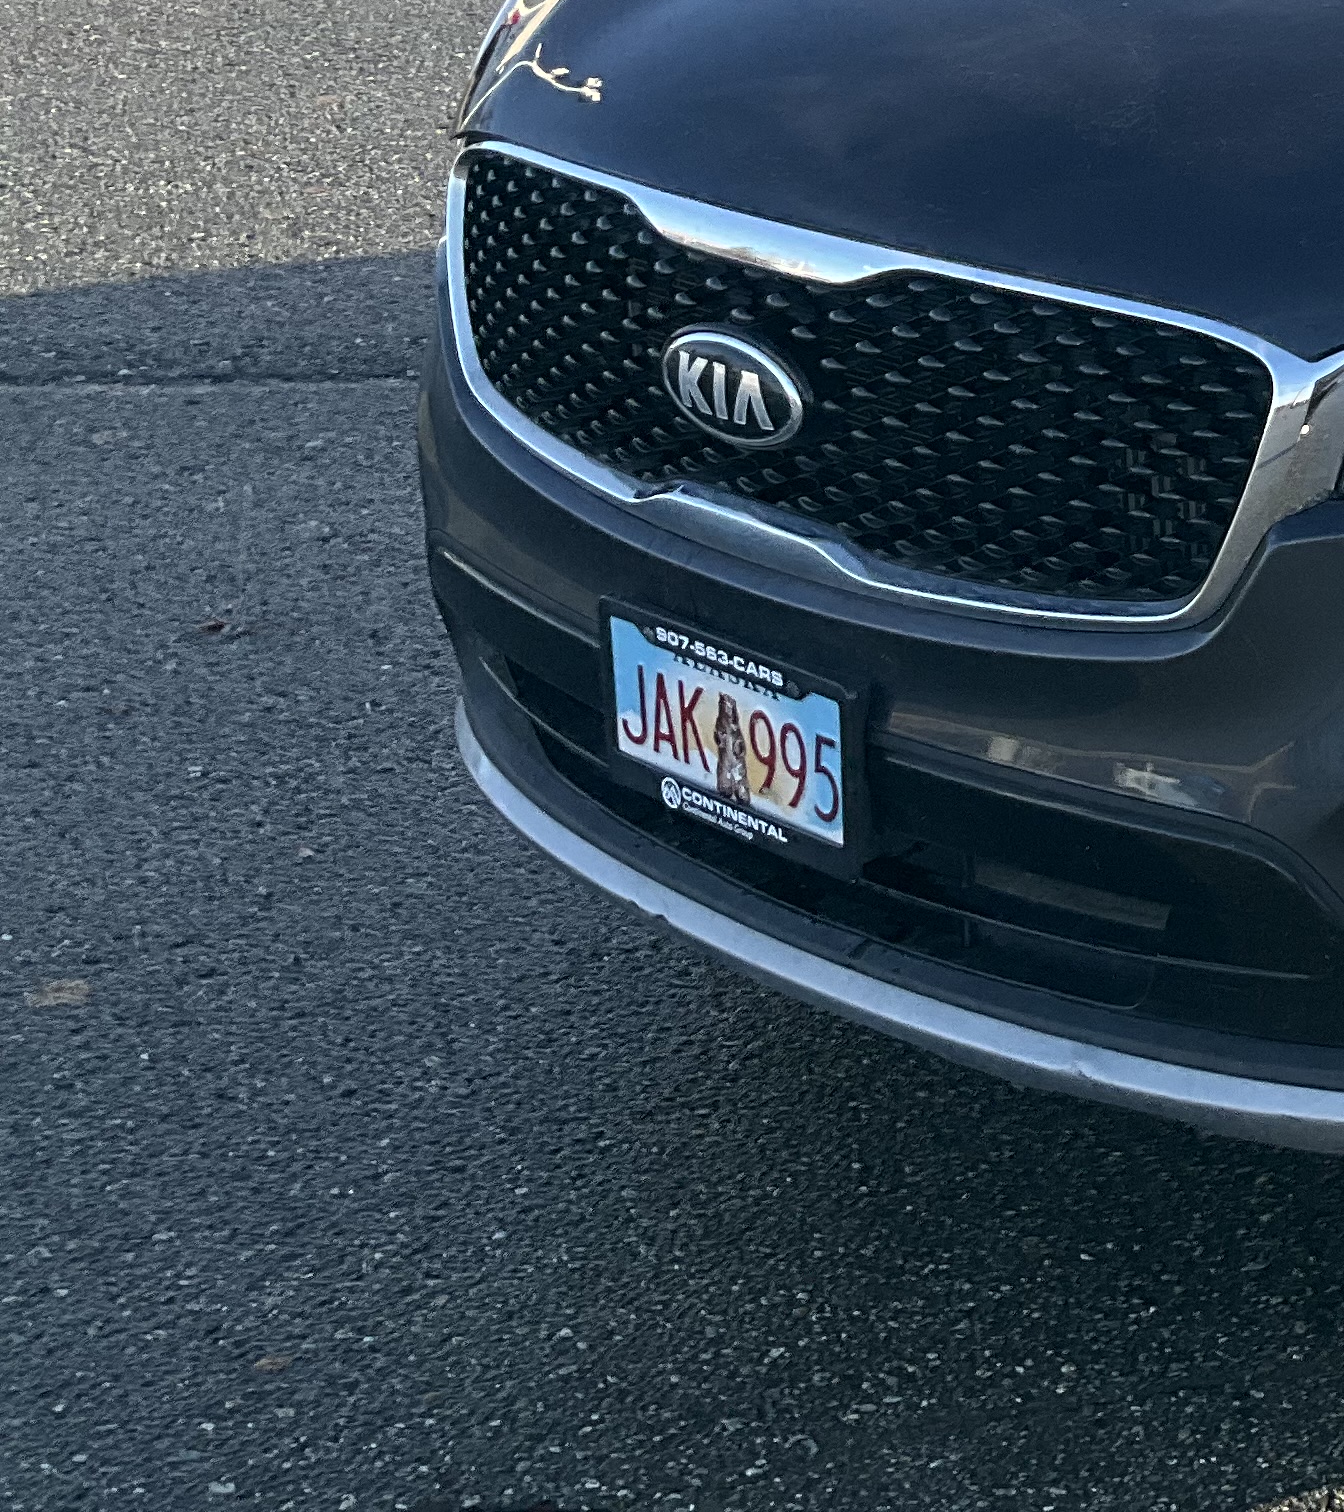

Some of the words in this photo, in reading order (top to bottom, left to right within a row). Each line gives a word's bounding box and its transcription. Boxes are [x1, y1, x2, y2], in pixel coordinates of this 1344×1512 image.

[678, 350, 775, 430] KIA
[655, 626, 784, 687] 907-563-CARS
[621, 664, 711, 773] JAK
[749, 709, 839, 823] 995
[681, 786, 788, 842] CONTINENTAL
